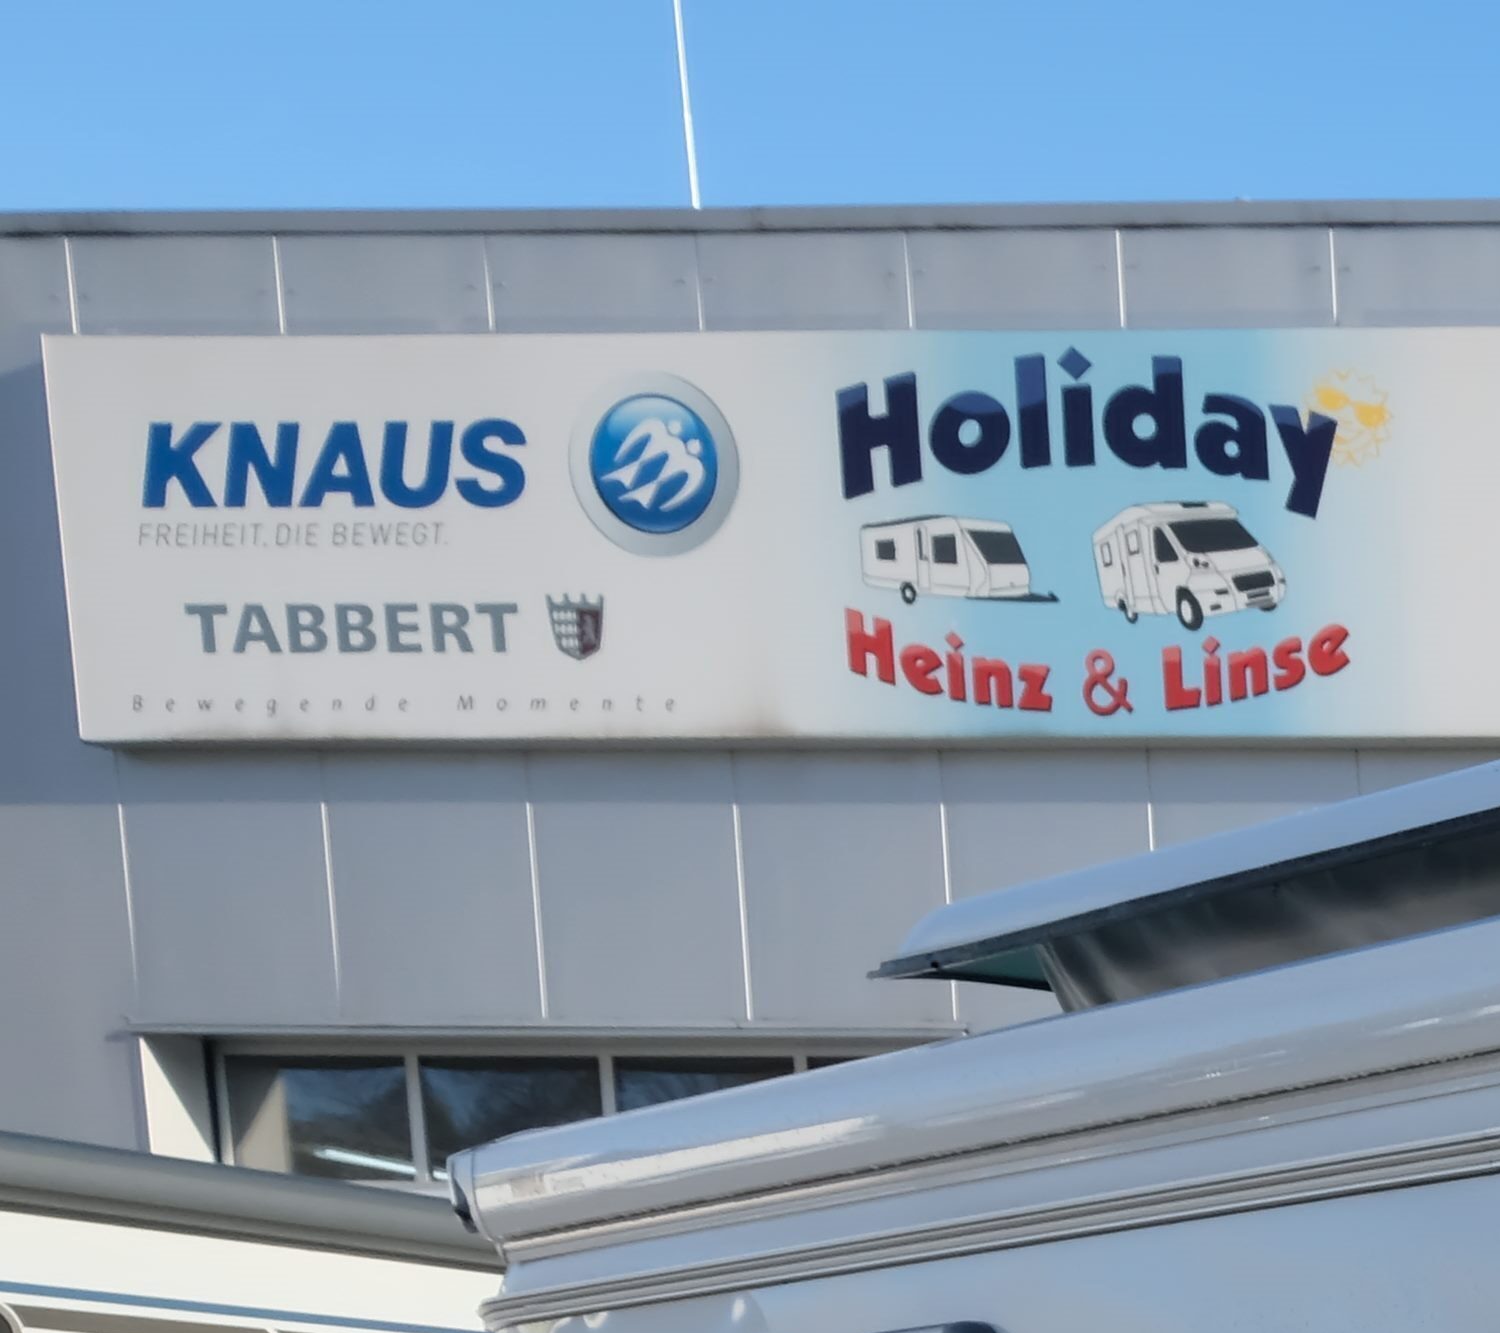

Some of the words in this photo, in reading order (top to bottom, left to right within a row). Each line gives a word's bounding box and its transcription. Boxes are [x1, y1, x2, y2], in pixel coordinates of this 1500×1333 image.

[142, 418, 528, 509] KNAUS
[835, 346, 1339, 520] Holiday
[185, 602, 520, 654] TABBERT
[845, 607, 1053, 712] Heinz
[1081, 648, 1134, 716] &
[1161, 623, 1352, 712] Linse
[131, 694, 410, 716] Bewegende
[456, 693, 678, 713] Momente
